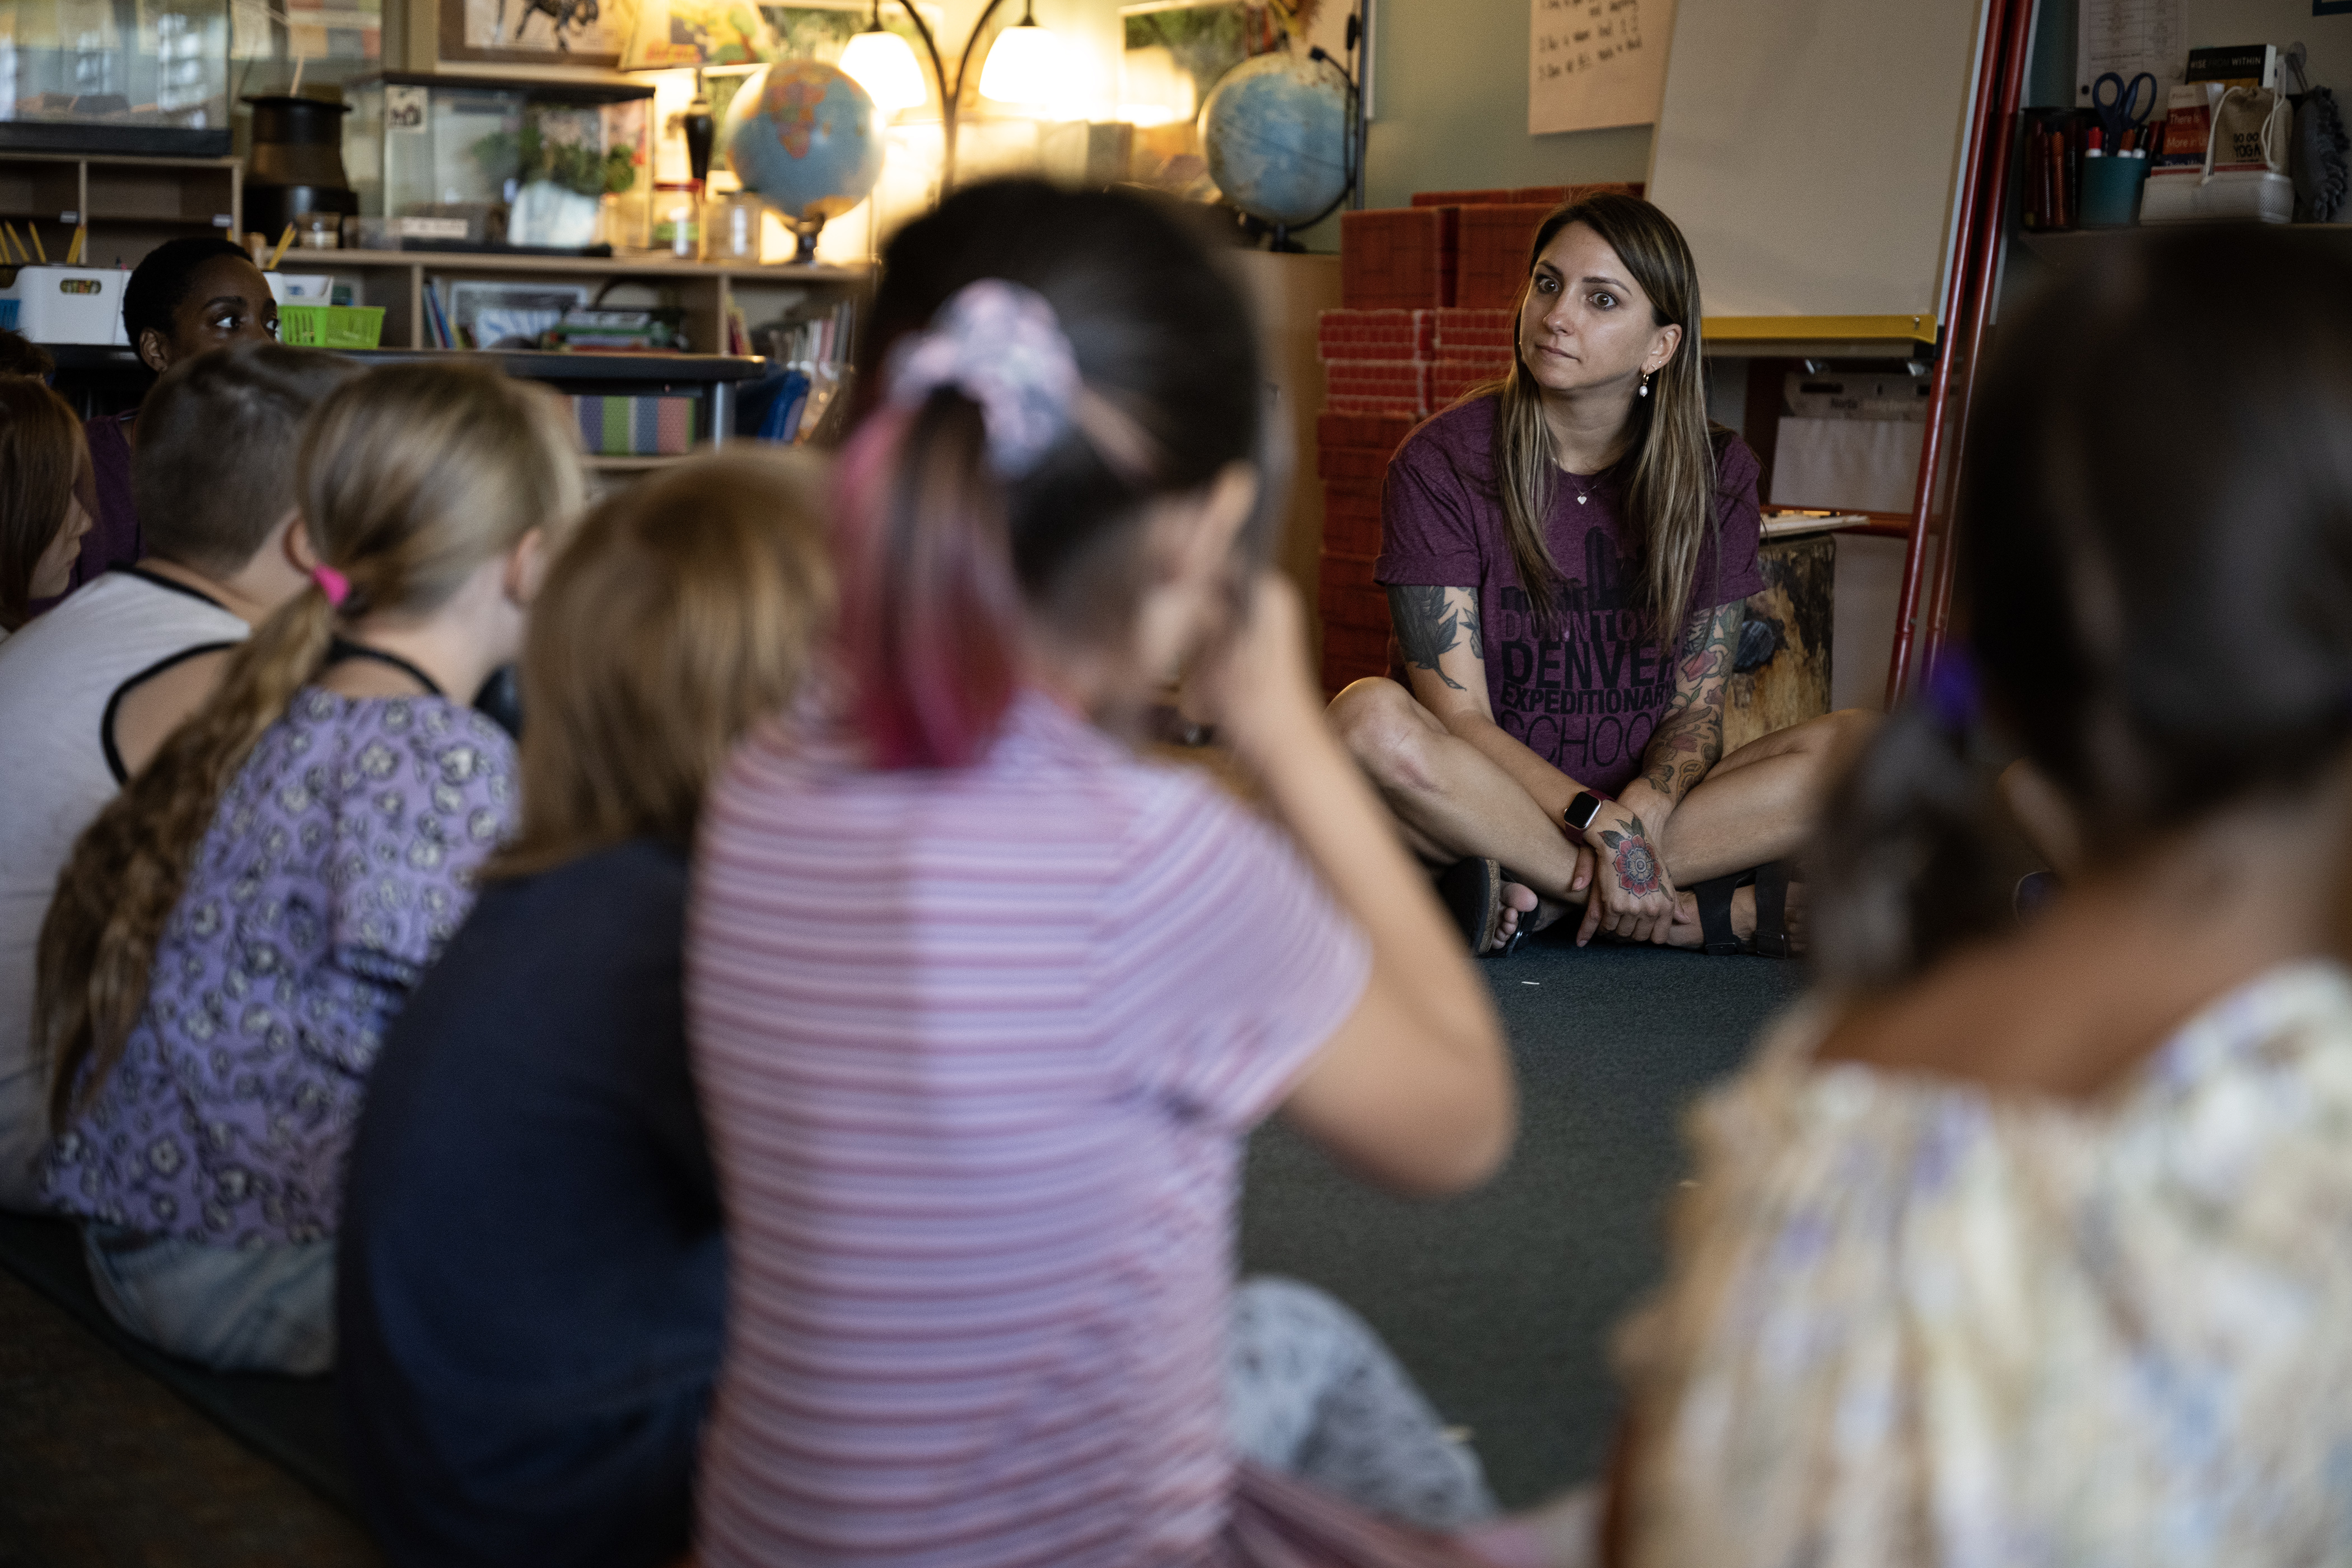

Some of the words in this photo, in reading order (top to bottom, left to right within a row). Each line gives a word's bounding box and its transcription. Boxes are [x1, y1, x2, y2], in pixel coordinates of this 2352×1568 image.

[2231, 56, 2261, 67] WITHIN
[2167, 136, 2188, 148] More
[2233, 143, 2261, 157] YOGA
[1499, 607, 1655, 643] DOWNTO
[1500, 709, 1654, 767] CHOO
